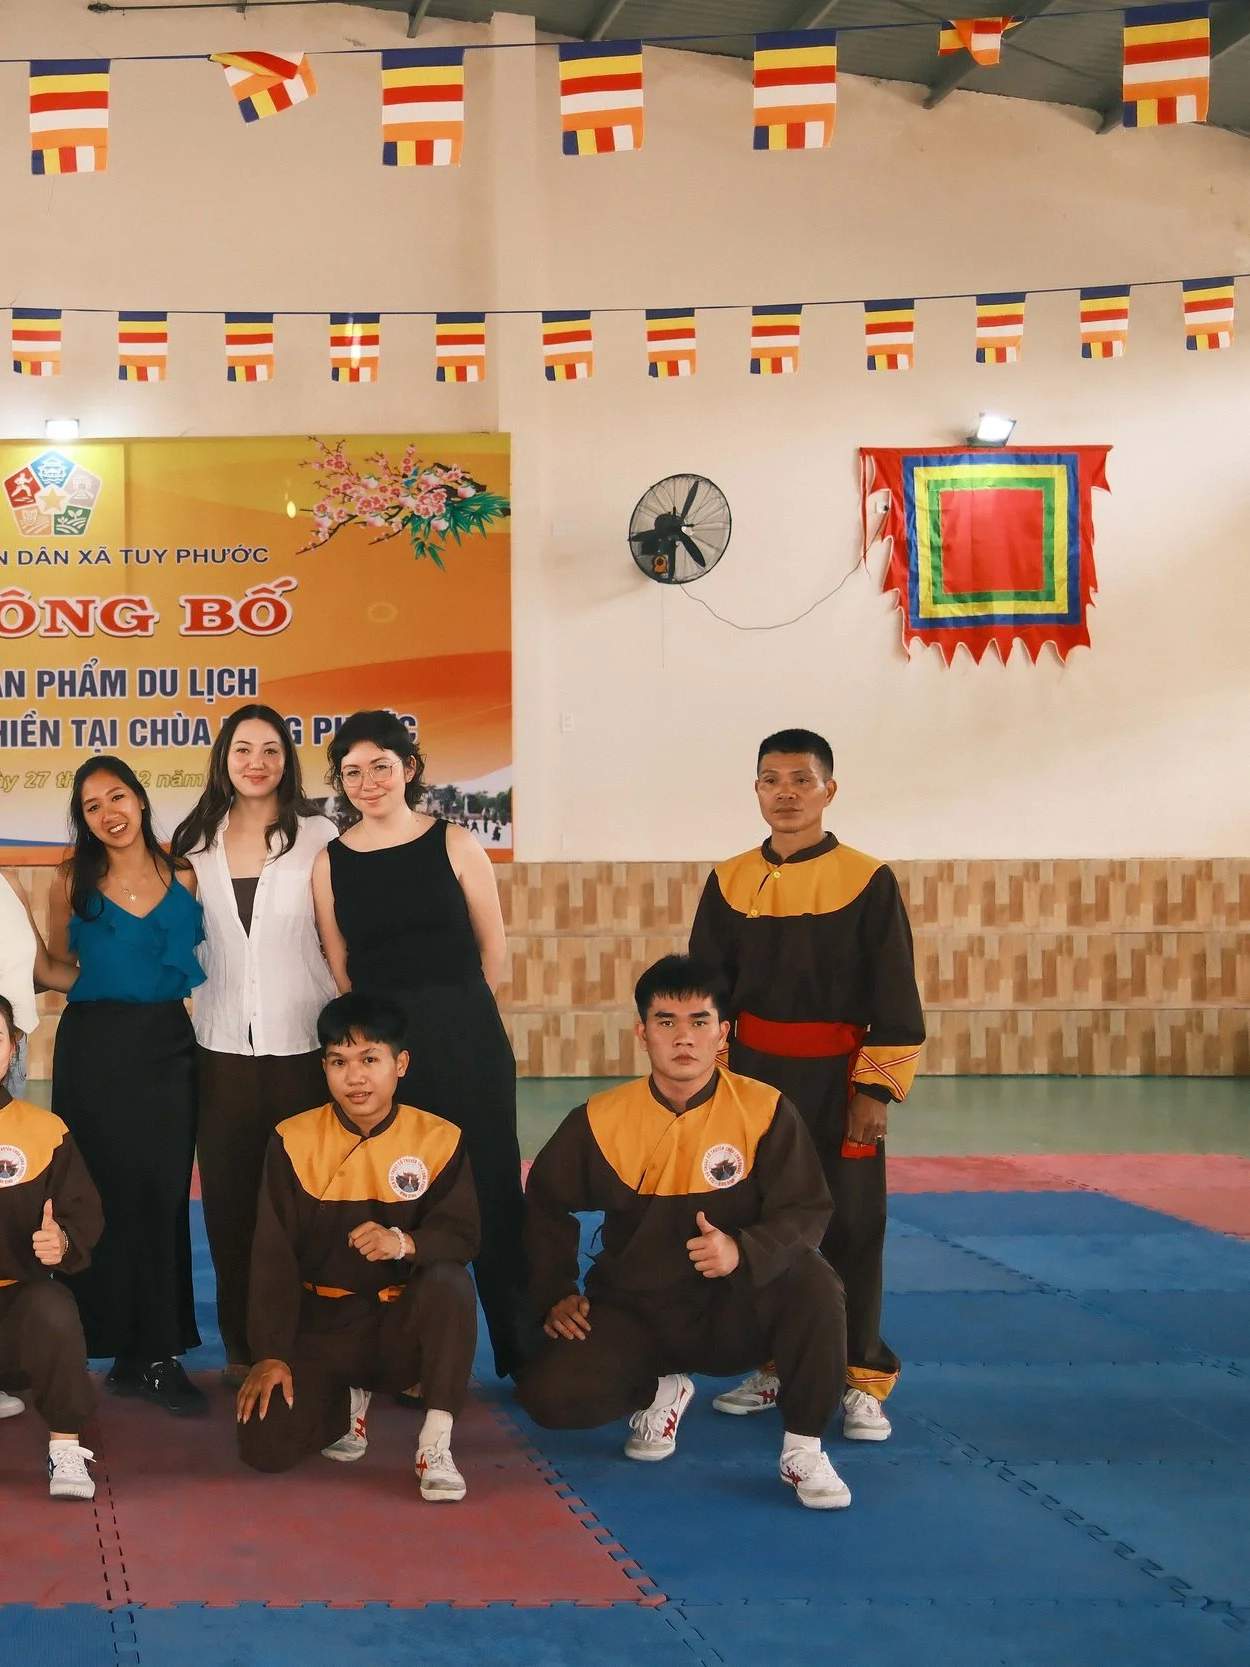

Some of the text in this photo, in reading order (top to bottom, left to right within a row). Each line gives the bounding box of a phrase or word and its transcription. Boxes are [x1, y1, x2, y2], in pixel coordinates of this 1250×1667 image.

[18, 547, 69, 565] DÂN
[78, 546, 111, 565] XÃ
[119, 548, 168, 564] TUY
[176, 544, 269, 564] PHƯỚC
[179, 576, 298, 636] BỐ
[37, 658, 127, 697] PHẨM
[138, 669, 178, 697] DU
[189, 668, 257, 703] LỊCH
[71, 718, 118, 753] TẠI
[129, 712, 211, 746] CHÙA
[24, 770, 51, 789] 27
[156, 769, 205, 788] năm
